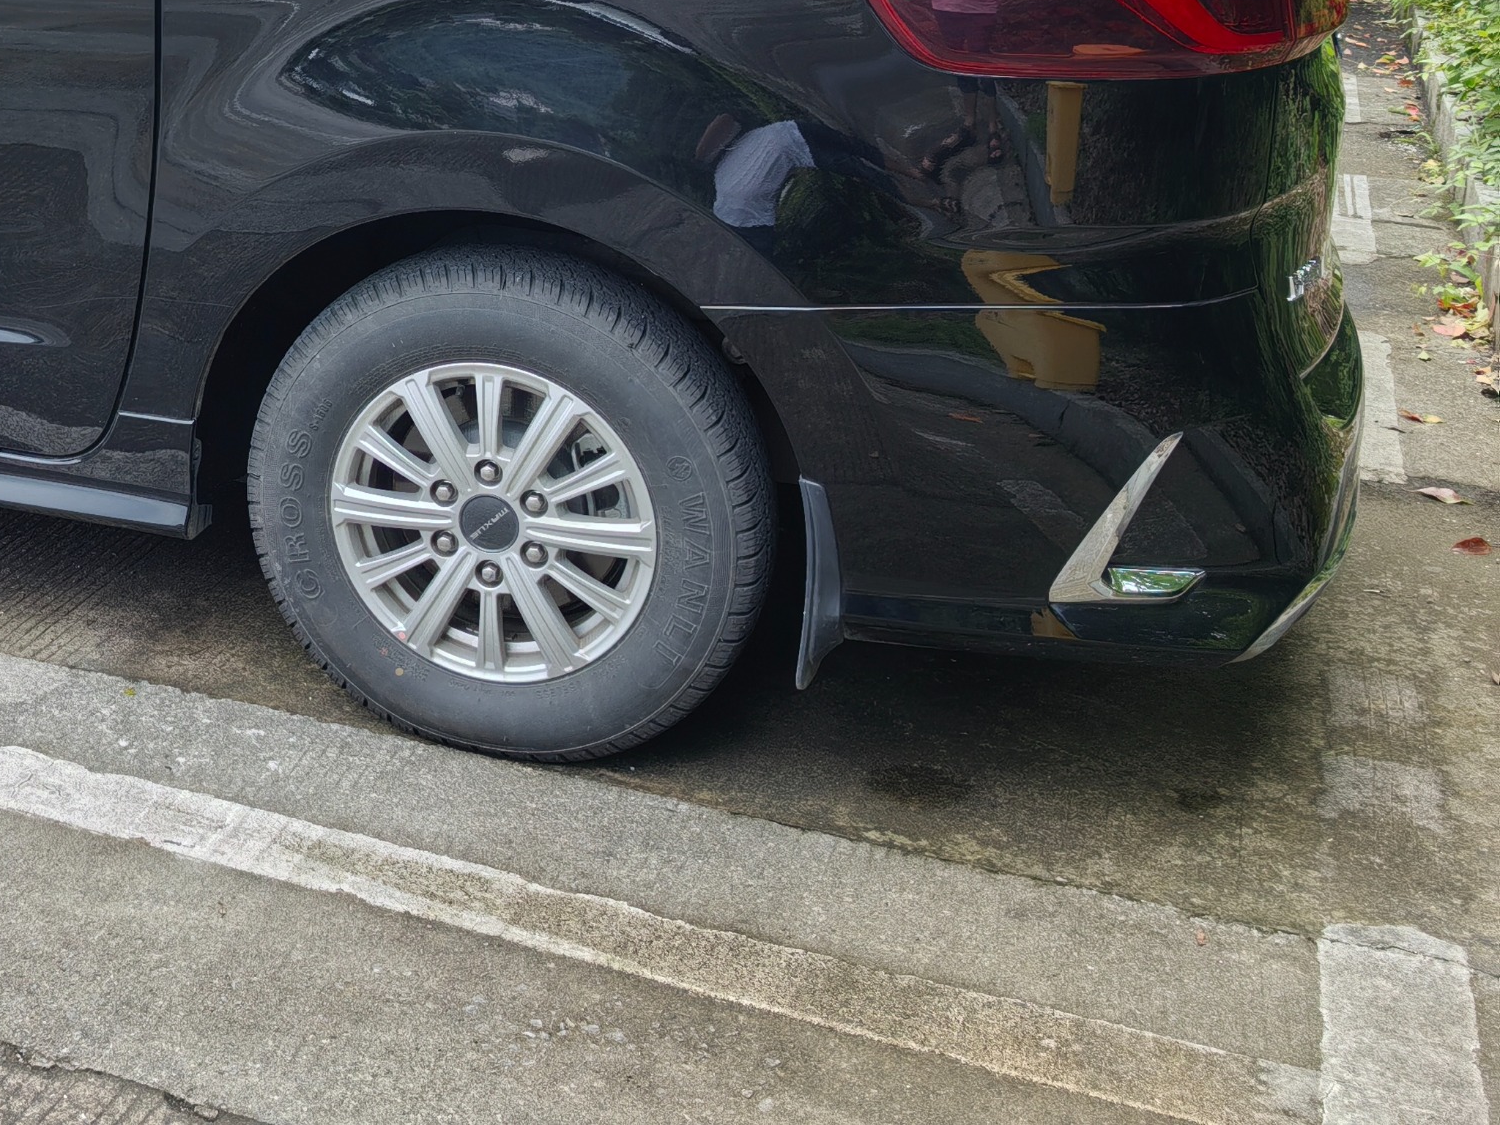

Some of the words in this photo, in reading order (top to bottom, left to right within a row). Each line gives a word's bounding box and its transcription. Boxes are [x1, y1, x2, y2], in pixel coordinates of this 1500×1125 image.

[278, 429, 325, 599] CROSS
[470, 507, 510, 540] MAXUS
[653, 491, 711, 666] WANLI
